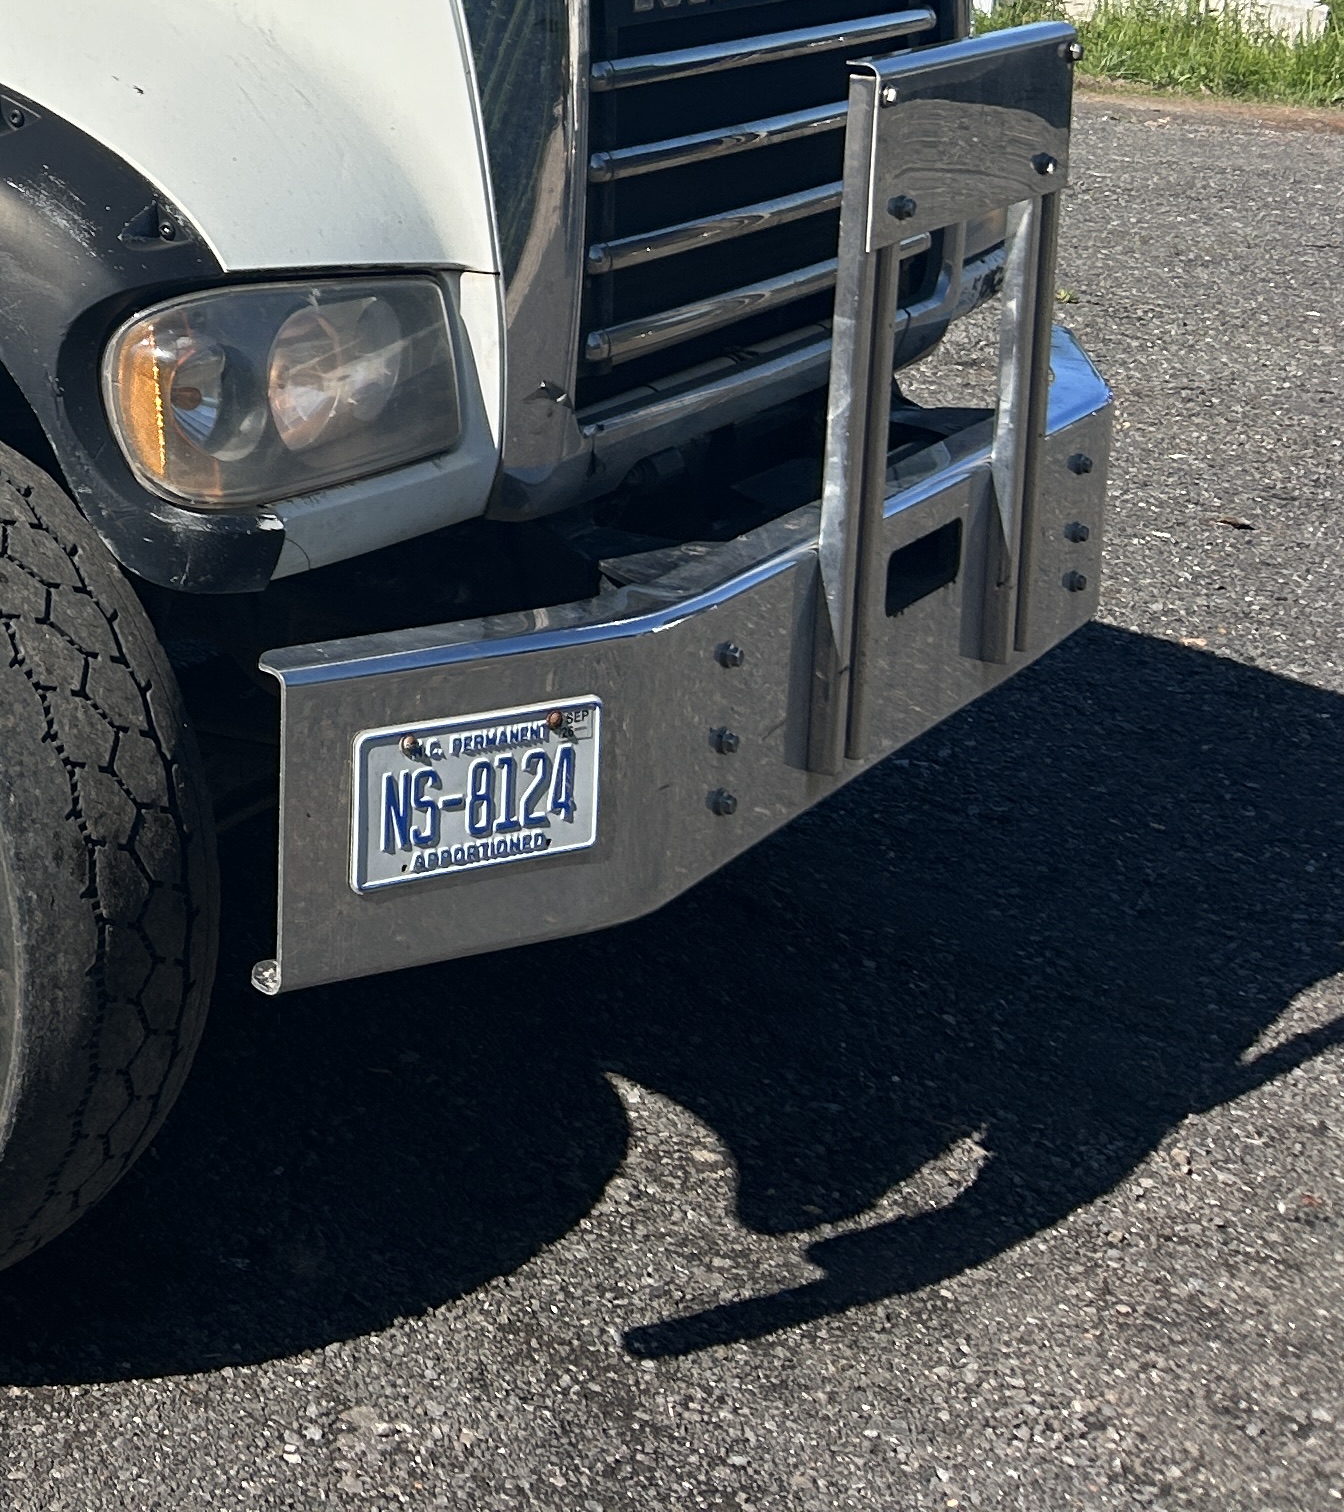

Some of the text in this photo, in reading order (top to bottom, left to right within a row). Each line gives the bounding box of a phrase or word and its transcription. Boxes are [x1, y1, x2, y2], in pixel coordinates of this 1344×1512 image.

[561, 725, 574, 739] 26
[566, 710, 589, 724] SEP
[449, 721, 549, 757] PERMANENT
[380, 743, 574, 853] NS-8124
[410, 830, 547, 873] APPORTIONED
